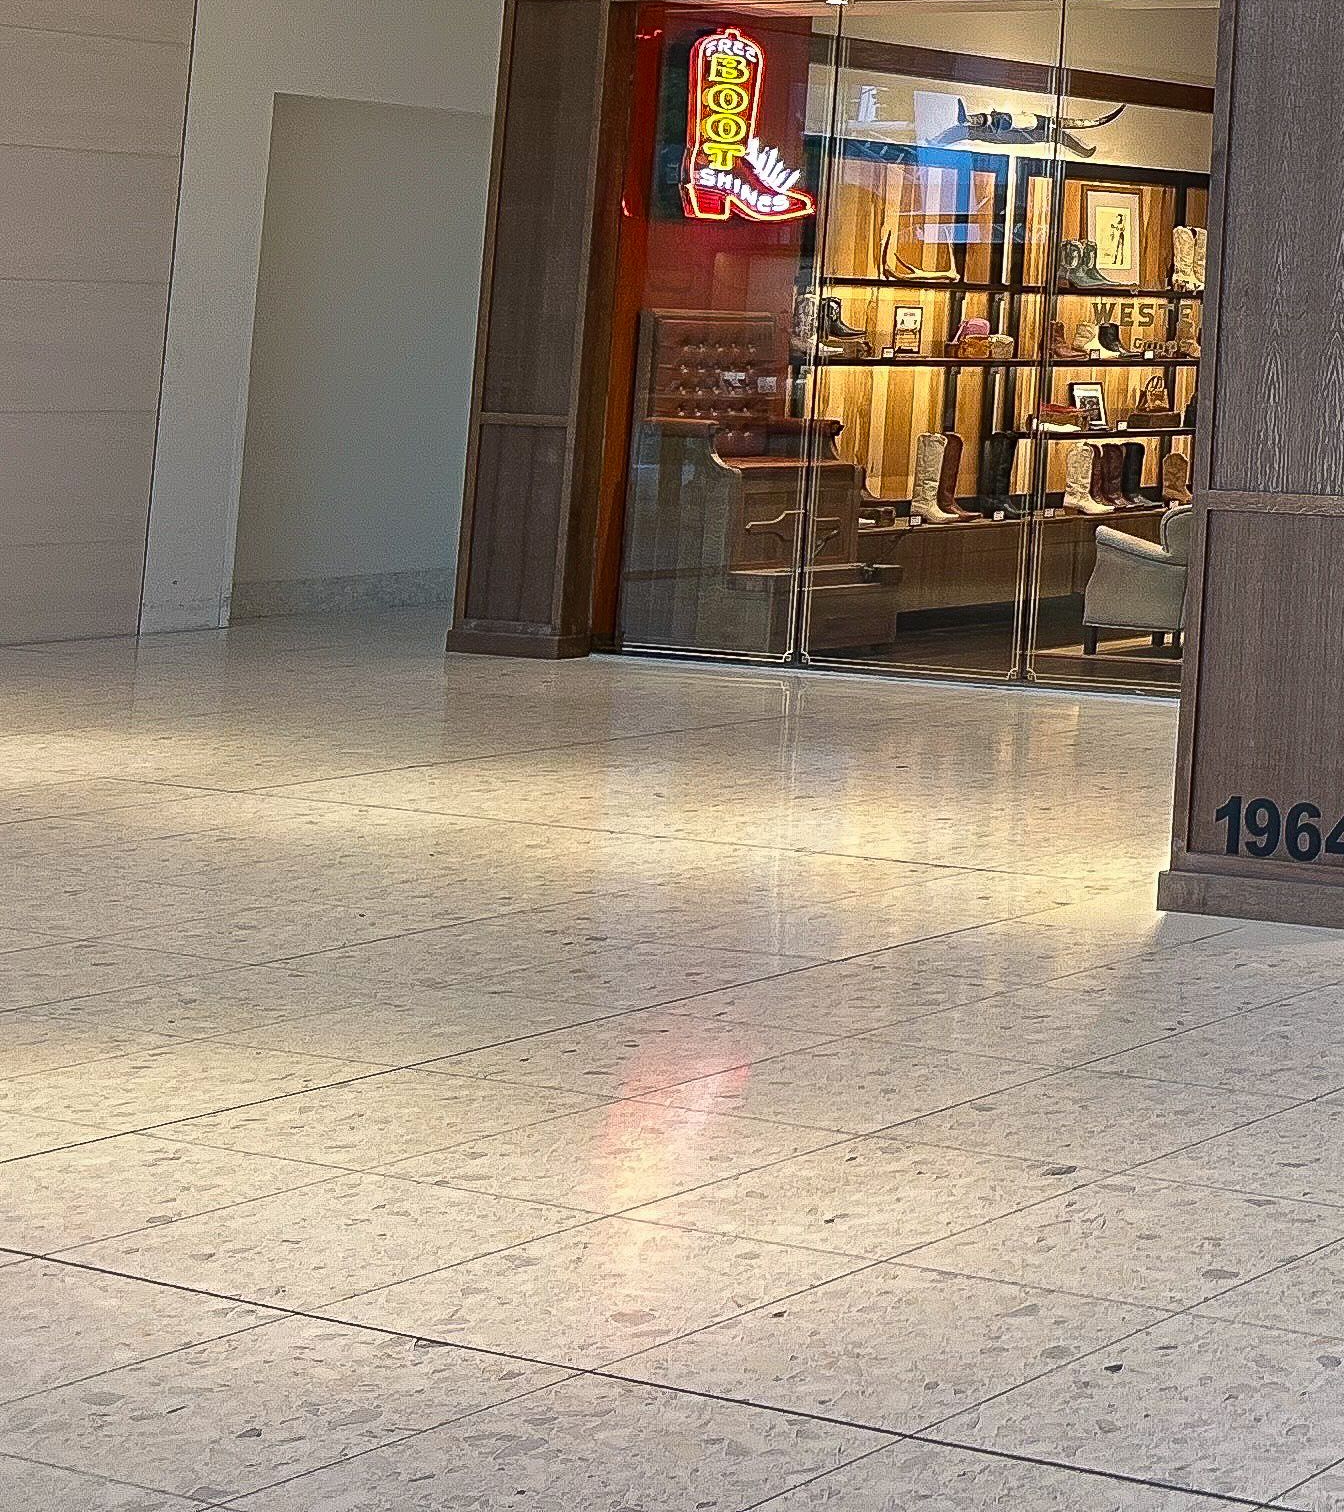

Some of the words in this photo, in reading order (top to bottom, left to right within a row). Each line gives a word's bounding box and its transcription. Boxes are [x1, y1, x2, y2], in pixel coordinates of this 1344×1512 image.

[705, 39, 758, 63] FREE
[702, 53, 751, 171] BOOT
[699, 167, 790, 213] SHINES
